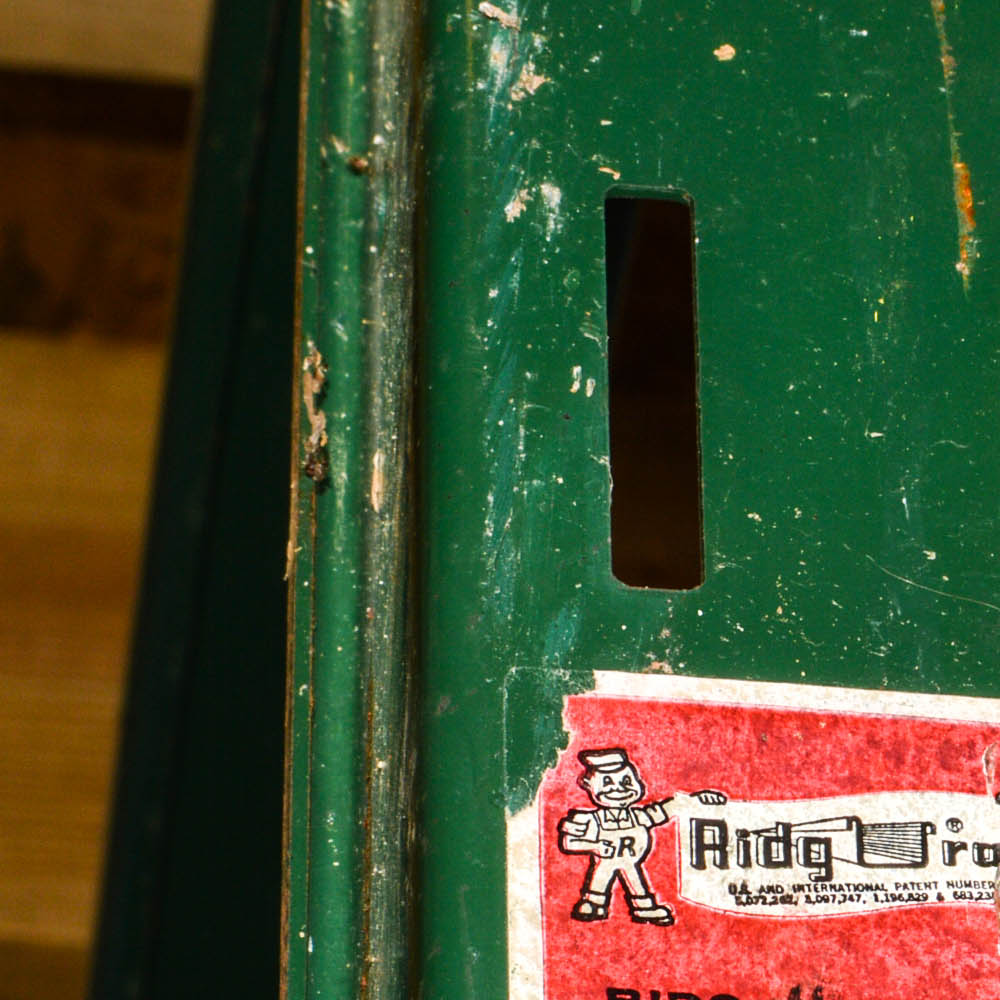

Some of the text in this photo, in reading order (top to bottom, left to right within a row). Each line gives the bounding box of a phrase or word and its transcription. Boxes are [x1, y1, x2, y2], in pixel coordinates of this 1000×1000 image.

[759, 884, 784, 894] AND
[792, 882, 888, 893] INTERNATIONAL
[895, 880, 938, 891] PATENT
[936, 891, 945, 901] &
